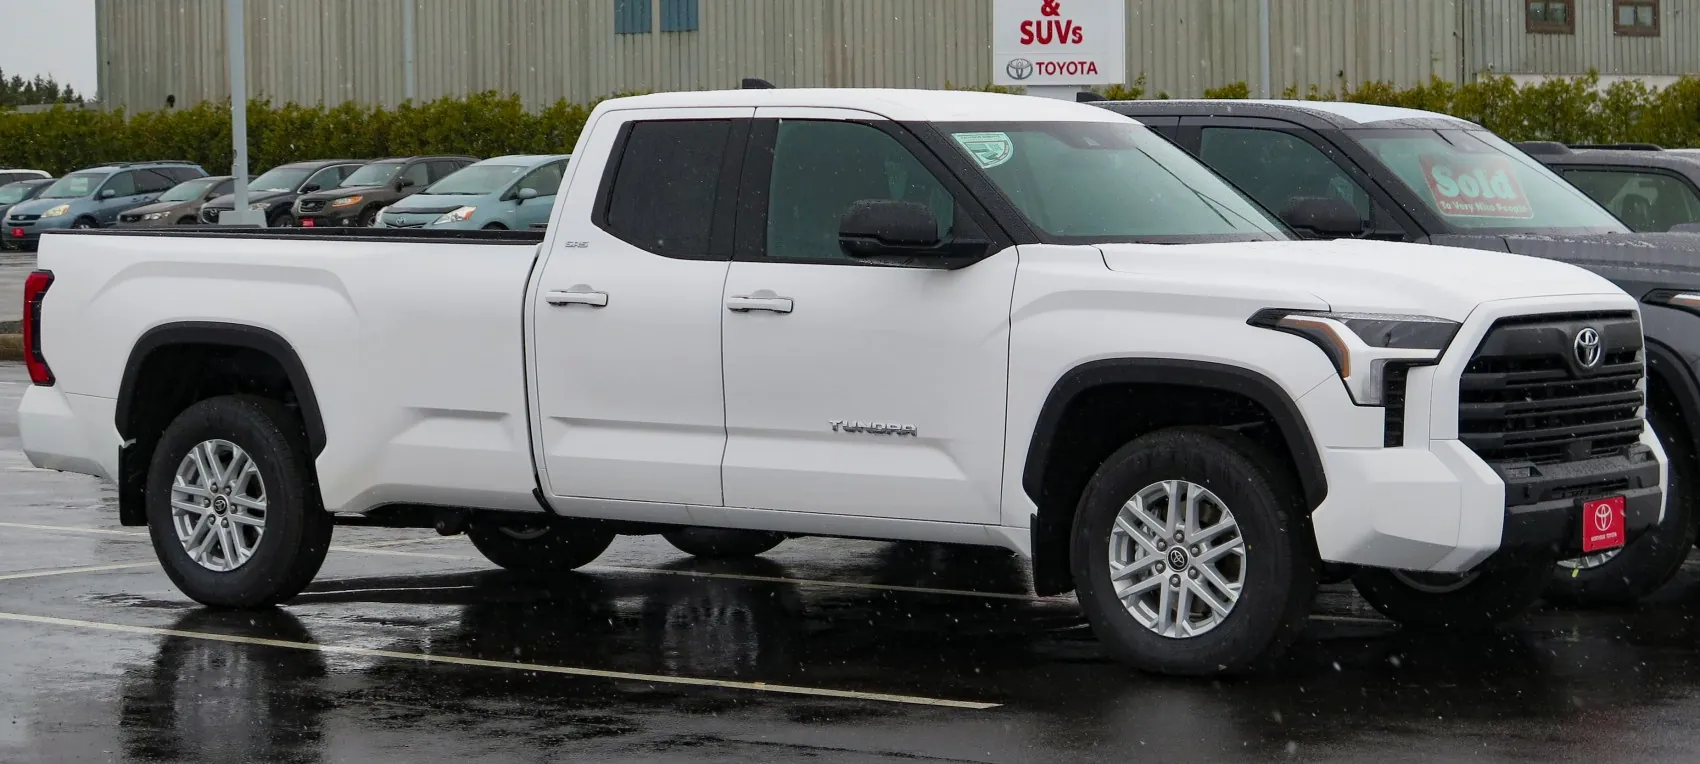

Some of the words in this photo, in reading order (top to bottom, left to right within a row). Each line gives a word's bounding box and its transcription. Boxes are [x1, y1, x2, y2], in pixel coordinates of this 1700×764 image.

[1041, 0, 1060, 17] &
[1020, 19, 1083, 45] SUVs
[1036, 61, 1098, 76] TOYOTA
[1432, 164, 1516, 199] Sold
[1441, 201, 1452, 210] To
[1453, 200, 1473, 213] Very
[828, 418, 918, 437] TUNDRA
